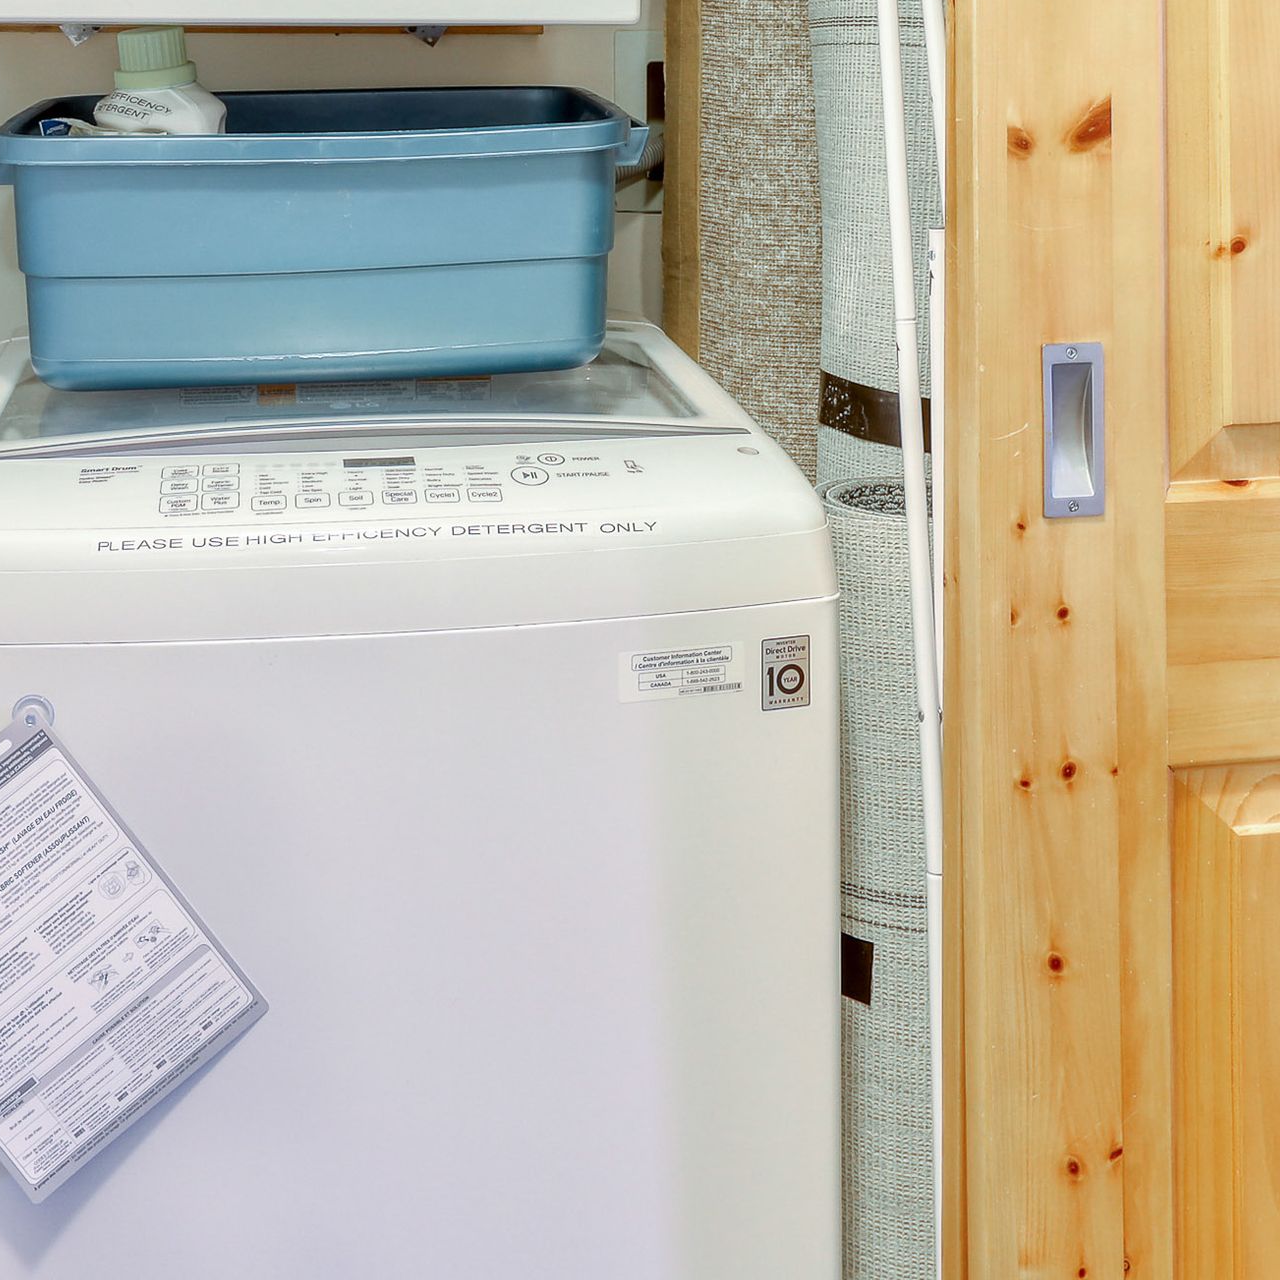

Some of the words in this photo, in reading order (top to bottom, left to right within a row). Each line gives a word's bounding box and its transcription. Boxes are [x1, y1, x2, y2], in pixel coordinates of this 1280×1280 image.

[97, 538, 183, 551] PLEASE
[192, 536, 240, 548] USE
[246, 533, 303, 545] HIGH
[451, 522, 588, 536] DETERGENT
[600, 521, 658, 533] ONLY
[670, 651, 703, 660] Information
[765, 646, 786, 656] Direct
[787, 645, 806, 653] Drive
[658, 659, 694, 667] d'information
[766, 663, 805, 697] 10
[769, 696, 804, 705] WARRANTY
[33, 814, 45, 826] EN
[41, 805, 56, 819] EAU
[12, 852, 44, 879] SOFTENER
